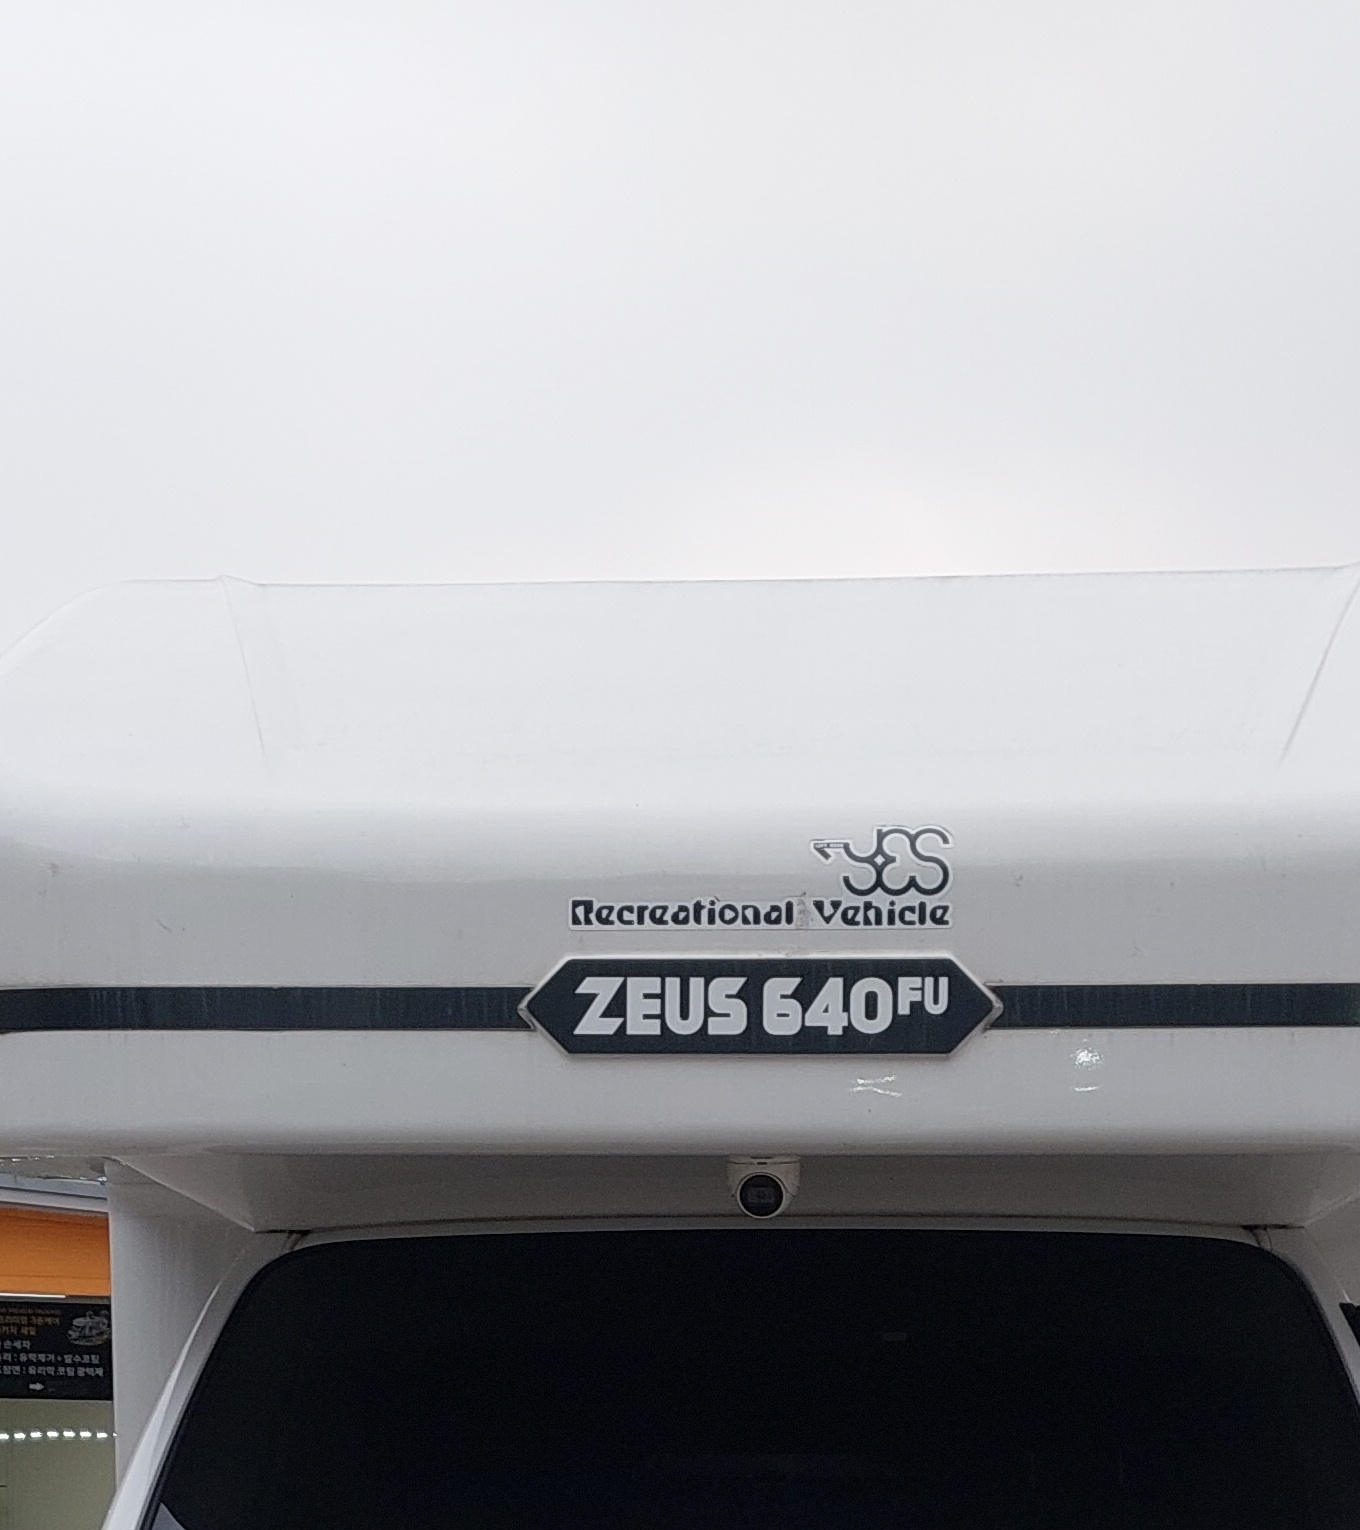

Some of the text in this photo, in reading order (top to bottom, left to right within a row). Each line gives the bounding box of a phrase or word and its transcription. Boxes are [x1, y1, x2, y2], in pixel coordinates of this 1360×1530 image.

[571, 900, 950, 926] Recreational Vehicle
[572, 977, 748, 1036] ZEUS
